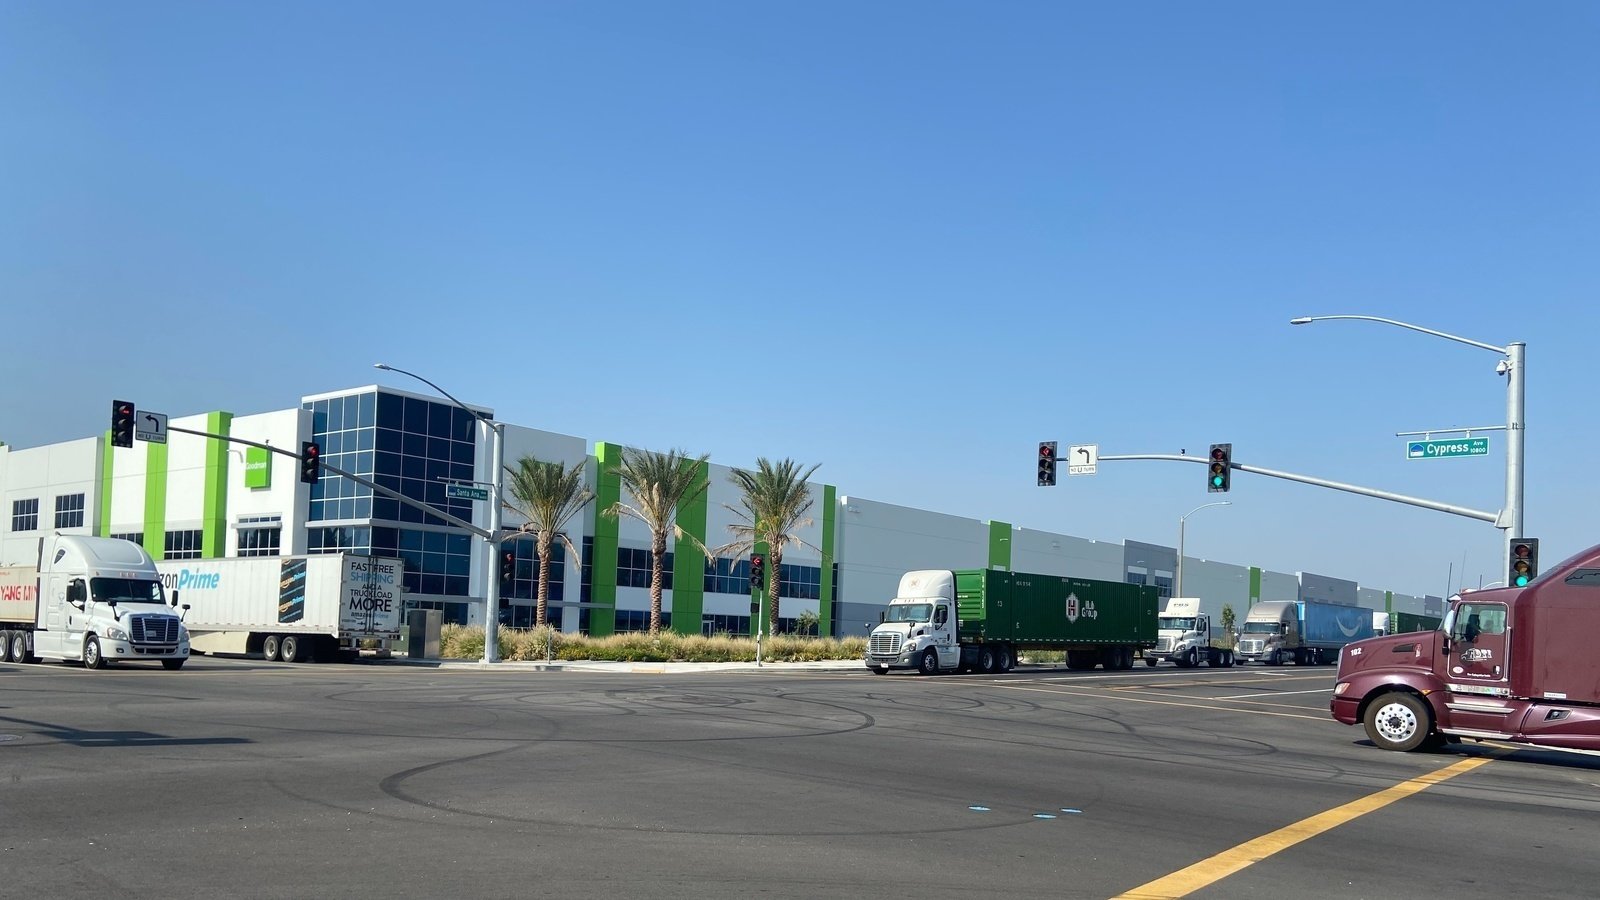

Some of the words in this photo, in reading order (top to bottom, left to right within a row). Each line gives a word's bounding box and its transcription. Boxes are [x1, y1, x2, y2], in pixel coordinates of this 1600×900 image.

[1427, 443, 1469, 456] Cypress
[456, 488, 470, 497] Santa
[471, 490, 480, 498] Ana
[350, 571, 394, 584] SHIPPING
[0, 585, 21, 601] YANG
[350, 588, 393, 599] TRUCKLOAD
[349, 596, 393, 613] MORE
[1081, 607, 1098, 620] Group
[1350, 647, 1362, 656] 102
